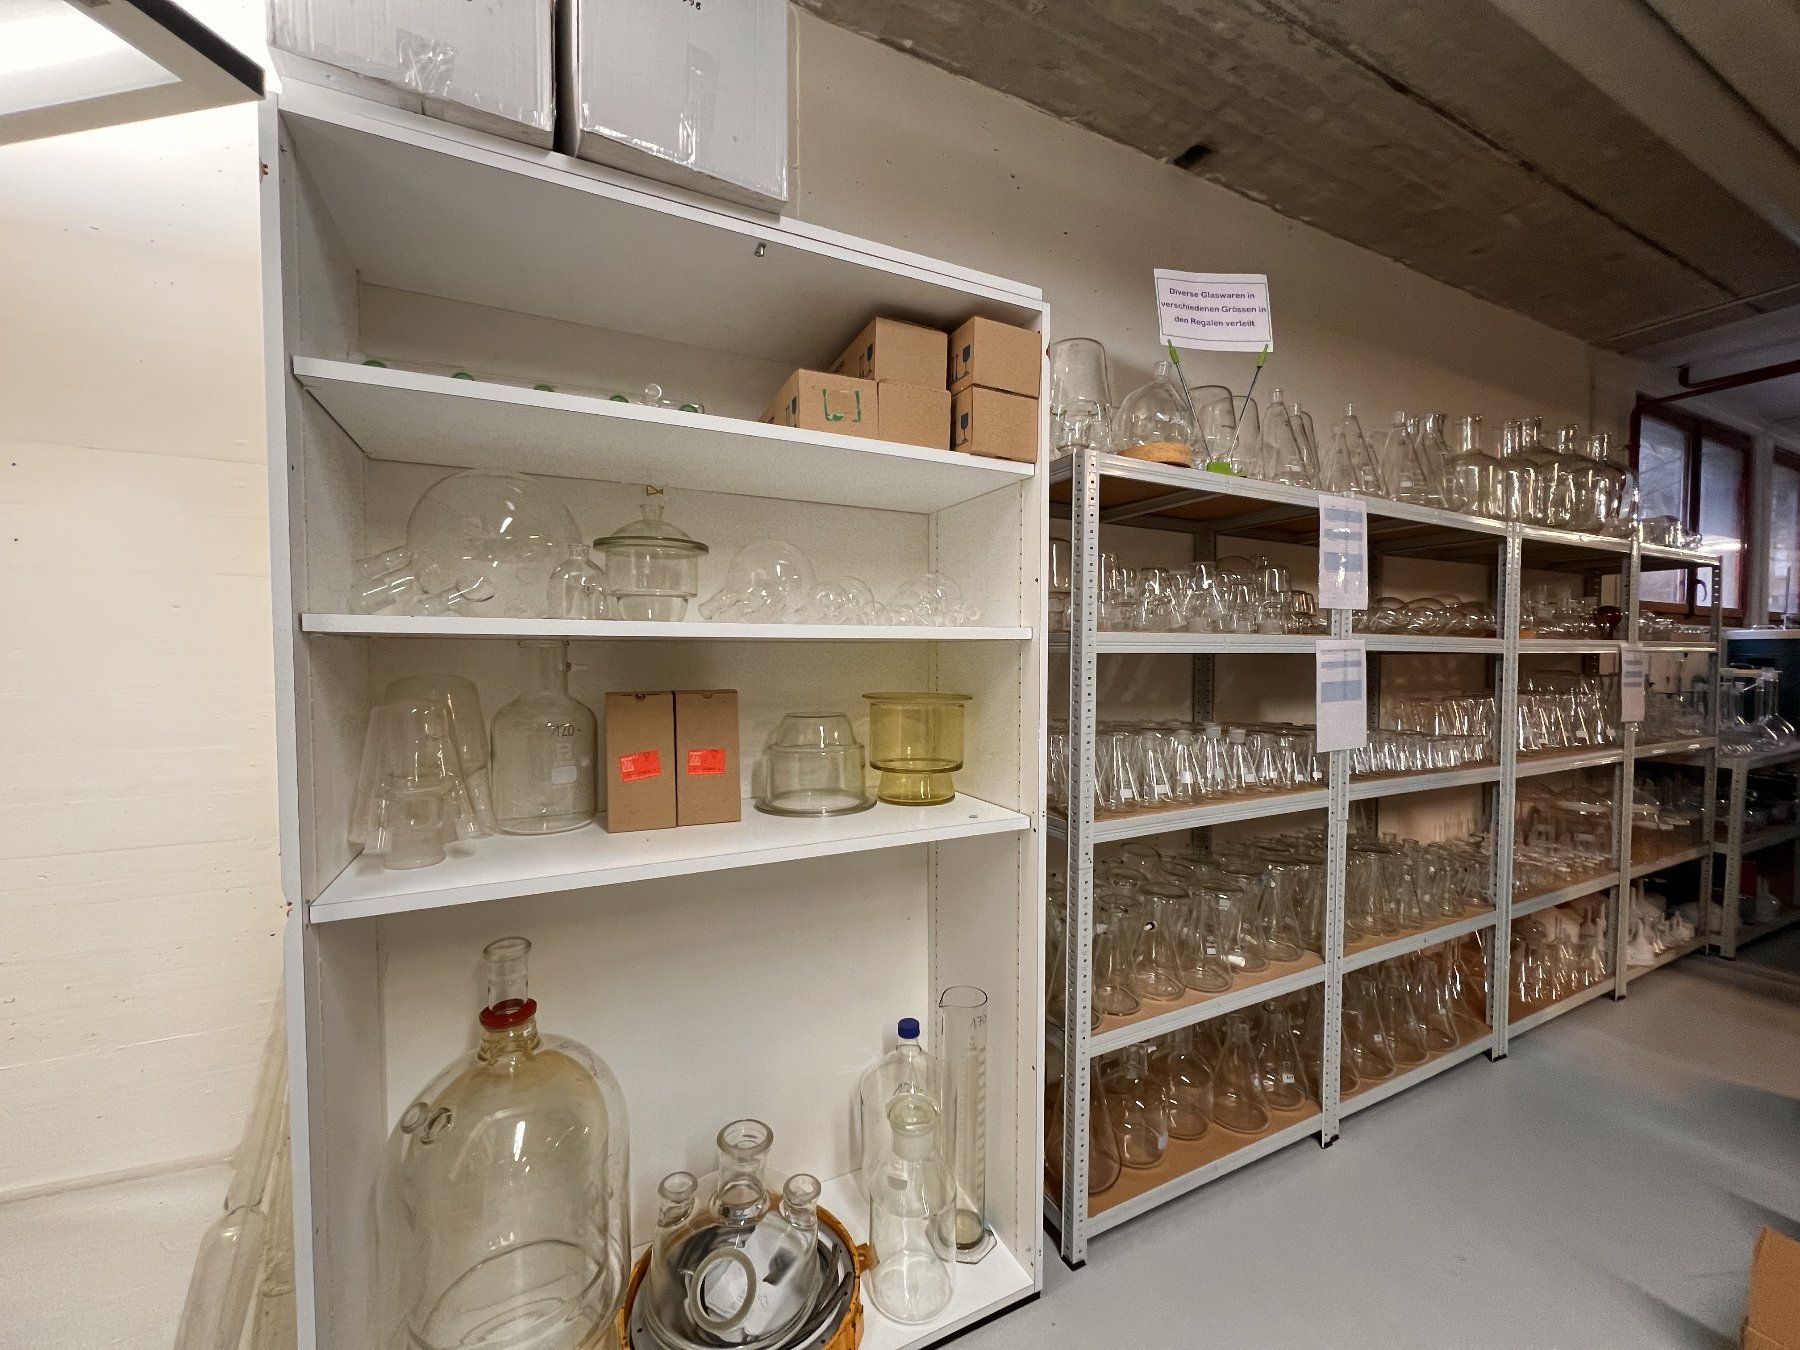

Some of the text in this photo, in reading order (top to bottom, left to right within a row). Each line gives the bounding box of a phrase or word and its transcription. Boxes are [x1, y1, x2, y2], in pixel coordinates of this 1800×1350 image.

[1169, 287, 1255, 299] Diverse Glaswaren in
[1160, 301, 1267, 313] verschiedenen Grössen in
[1174, 315, 1255, 328] den Regalen verteilt
